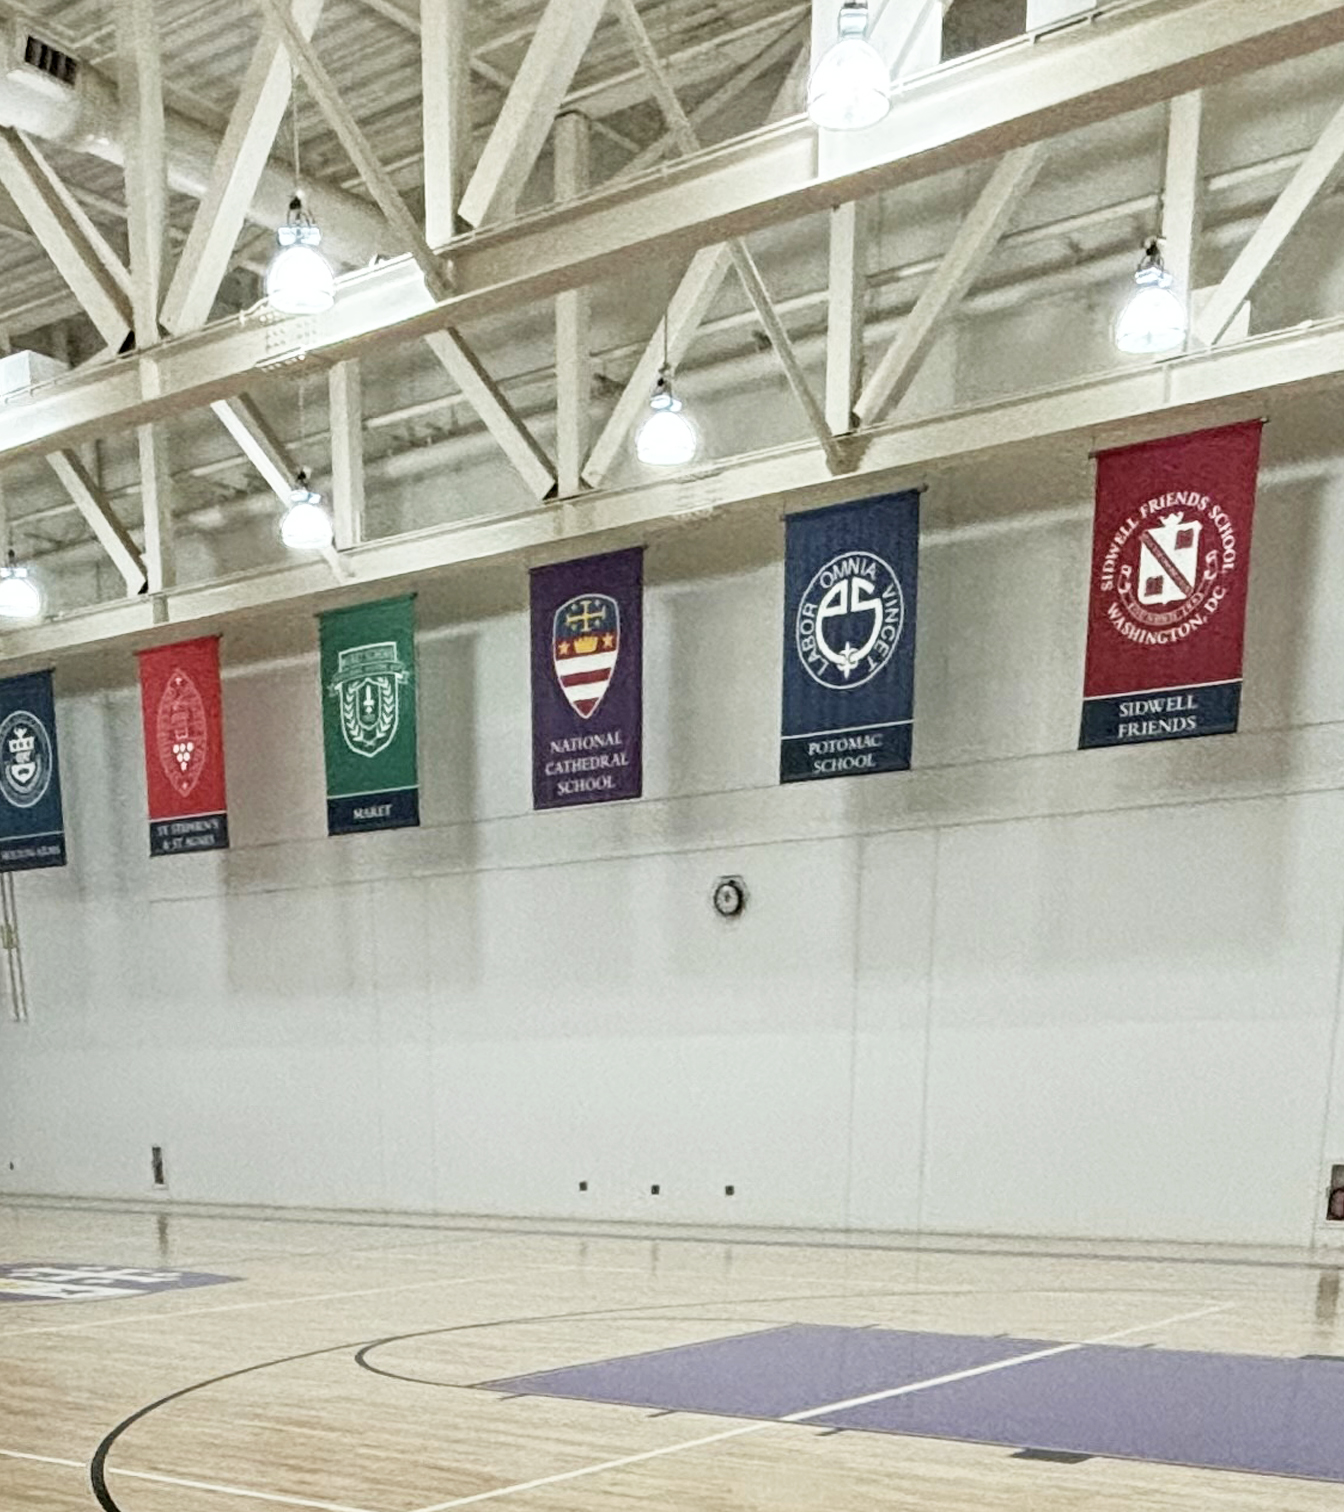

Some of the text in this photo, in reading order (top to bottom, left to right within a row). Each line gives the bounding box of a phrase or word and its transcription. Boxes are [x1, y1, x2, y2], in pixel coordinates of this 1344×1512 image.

[1100, 491, 1236, 592] SIDWELL FRIENDS SCHOOL
[801, 557, 900, 677] LABOR OMNIA VINCET
[1106, 602, 1208, 646] WASHINGTON,
[1205, 584, 1227, 615] DC
[1118, 694, 1198, 718] SIDWELL
[1117, 714, 1197, 740] FRIENDS
[550, 730, 623, 754] NATIONAL
[807, 733, 883, 756] POTOMAC
[544, 753, 629, 776] CATHEDRAL
[812, 753, 877, 775] SCHOOL
[557, 775, 616, 796] SCHOOL
